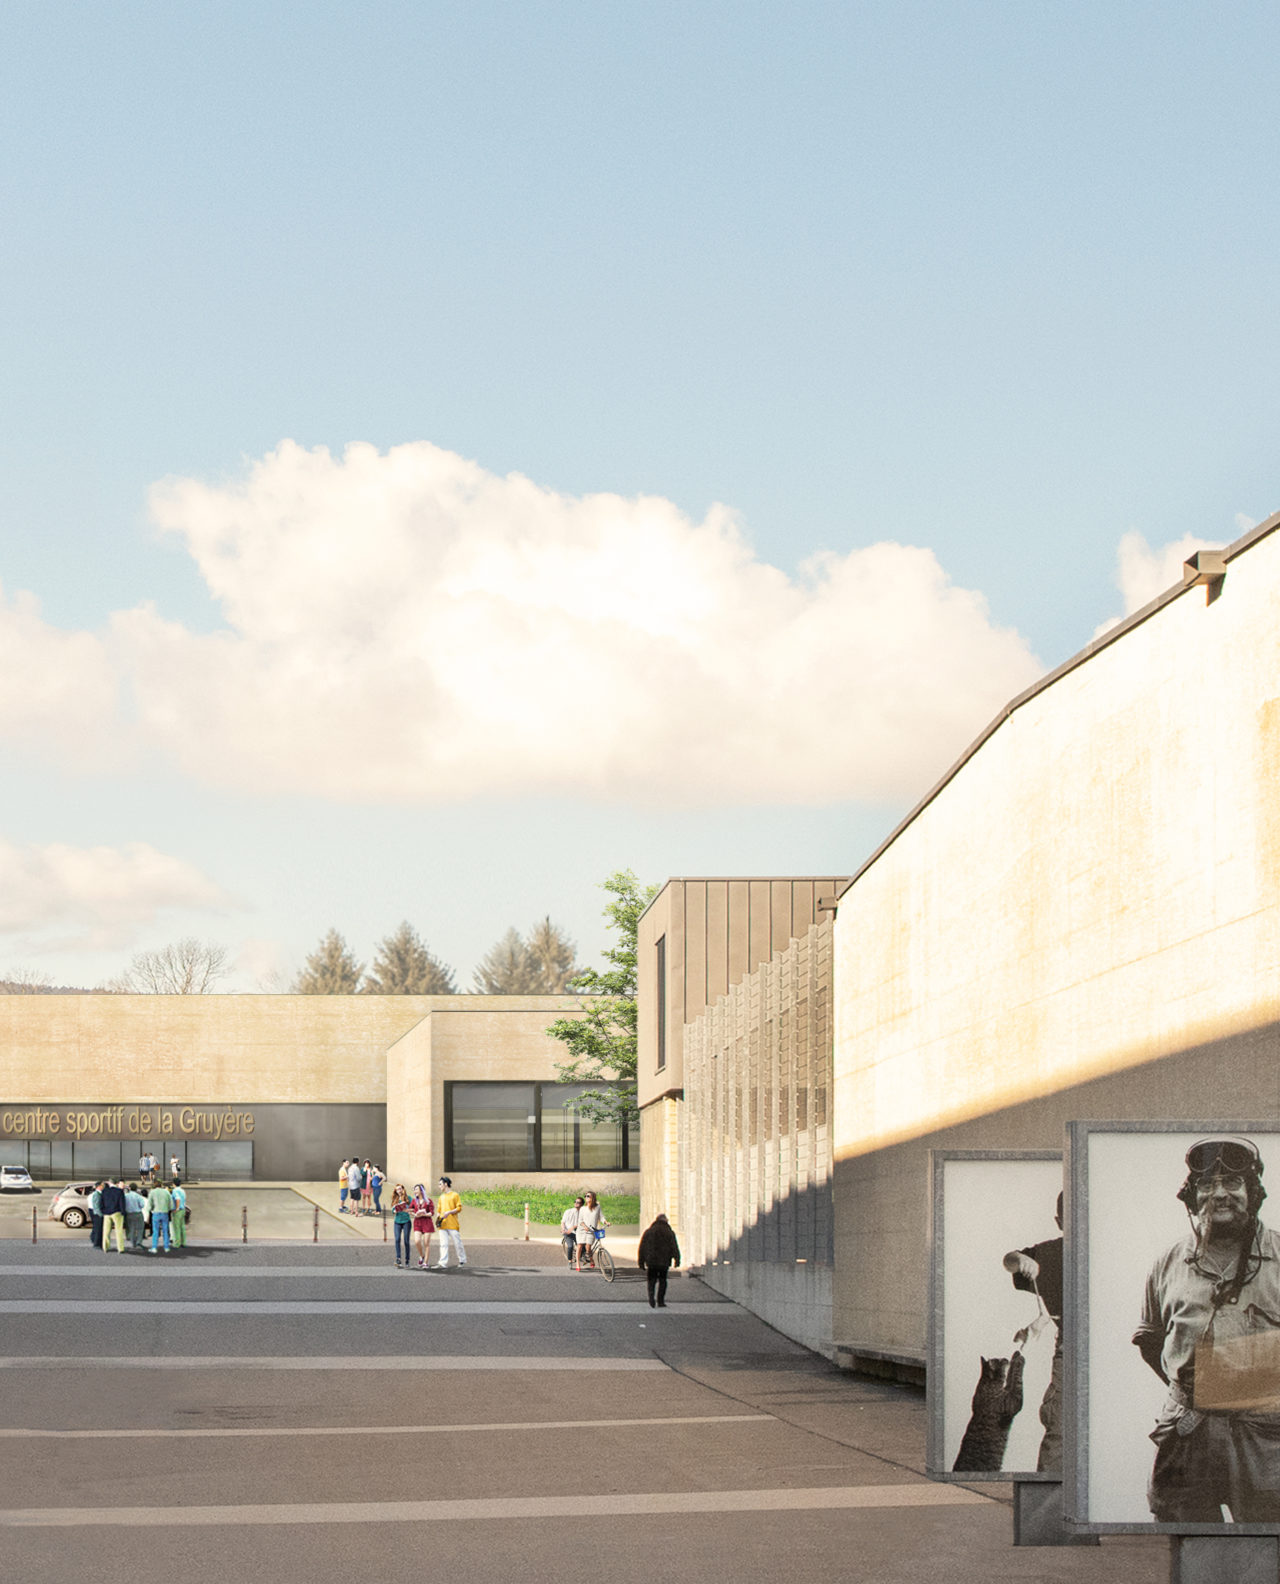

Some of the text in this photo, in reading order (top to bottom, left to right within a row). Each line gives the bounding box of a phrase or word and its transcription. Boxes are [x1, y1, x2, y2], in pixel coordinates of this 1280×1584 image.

[3, 1105, 255, 1140] centre sportif de la Gruyère
